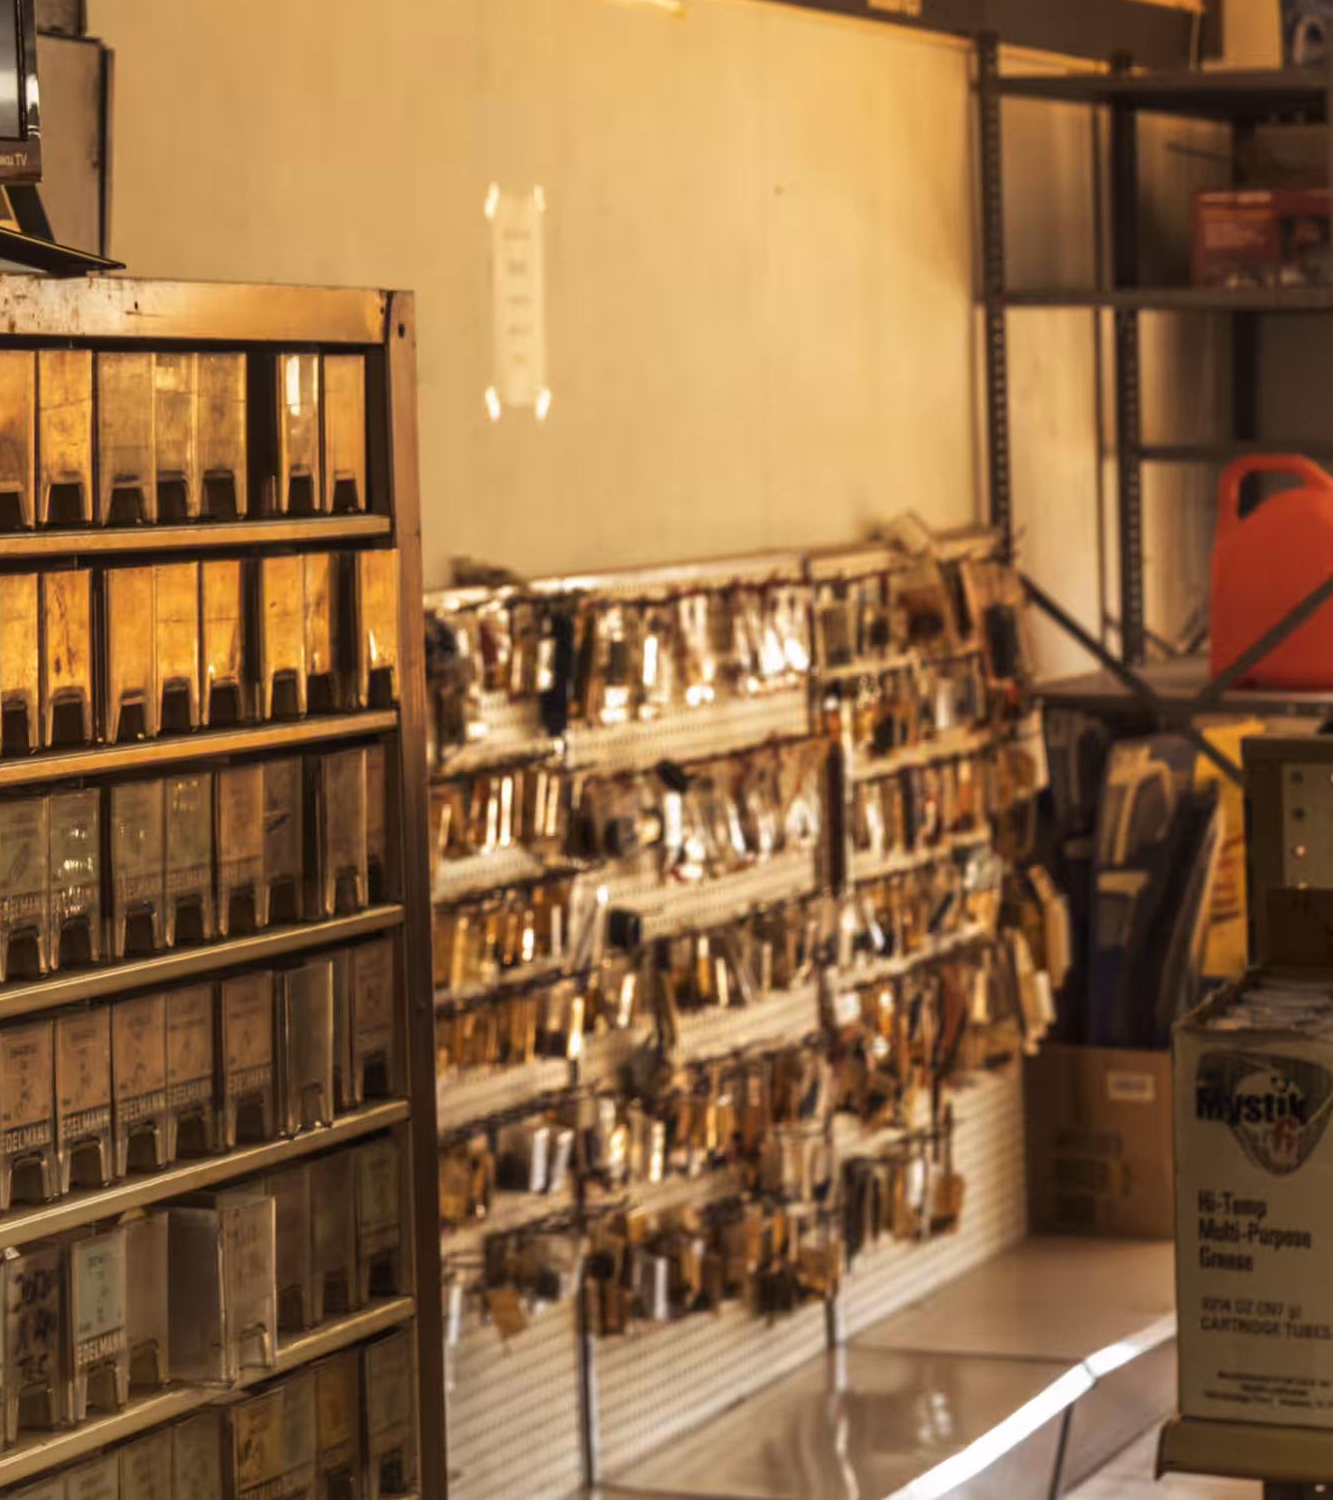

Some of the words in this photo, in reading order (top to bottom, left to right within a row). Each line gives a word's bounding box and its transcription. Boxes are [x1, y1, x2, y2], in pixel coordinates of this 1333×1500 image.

[14, 153, 27, 166] TV
[1196, 1086, 1306, 1126] Mystik
[1198, 1189, 1268, 1222] Hi-Temp
[1198, 1218, 1312, 1252] Multi-Purpose
